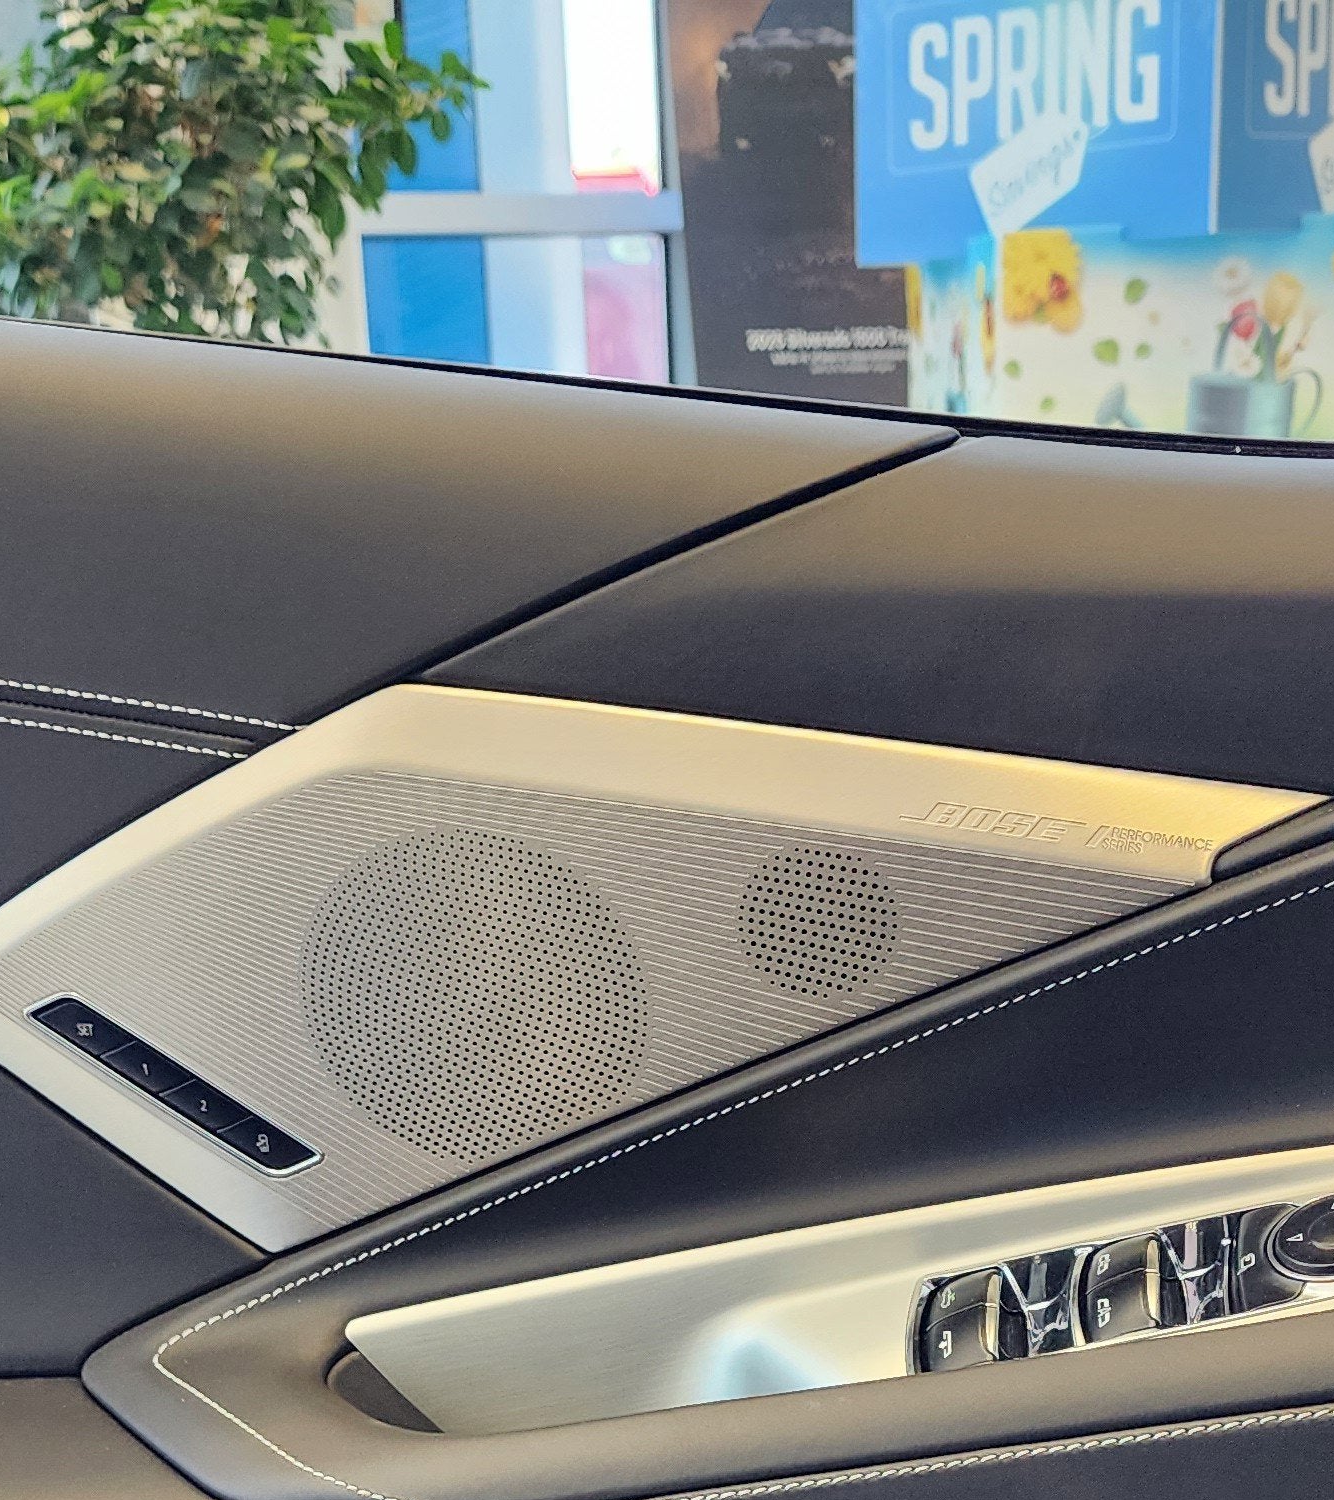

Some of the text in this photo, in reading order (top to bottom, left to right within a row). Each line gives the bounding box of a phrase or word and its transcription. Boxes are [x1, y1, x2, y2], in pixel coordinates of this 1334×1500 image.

[908, 0, 1162, 150] SPRING
[899, 801, 1086, 843] BOSE
[1101, 837, 1143, 854] SERIES
[1111, 826, 1214, 852] PERFORMANCE
[76, 1022, 93, 1036] SET
[142, 1062, 149, 1076] 1
[200, 1099, 208, 1112] 2
